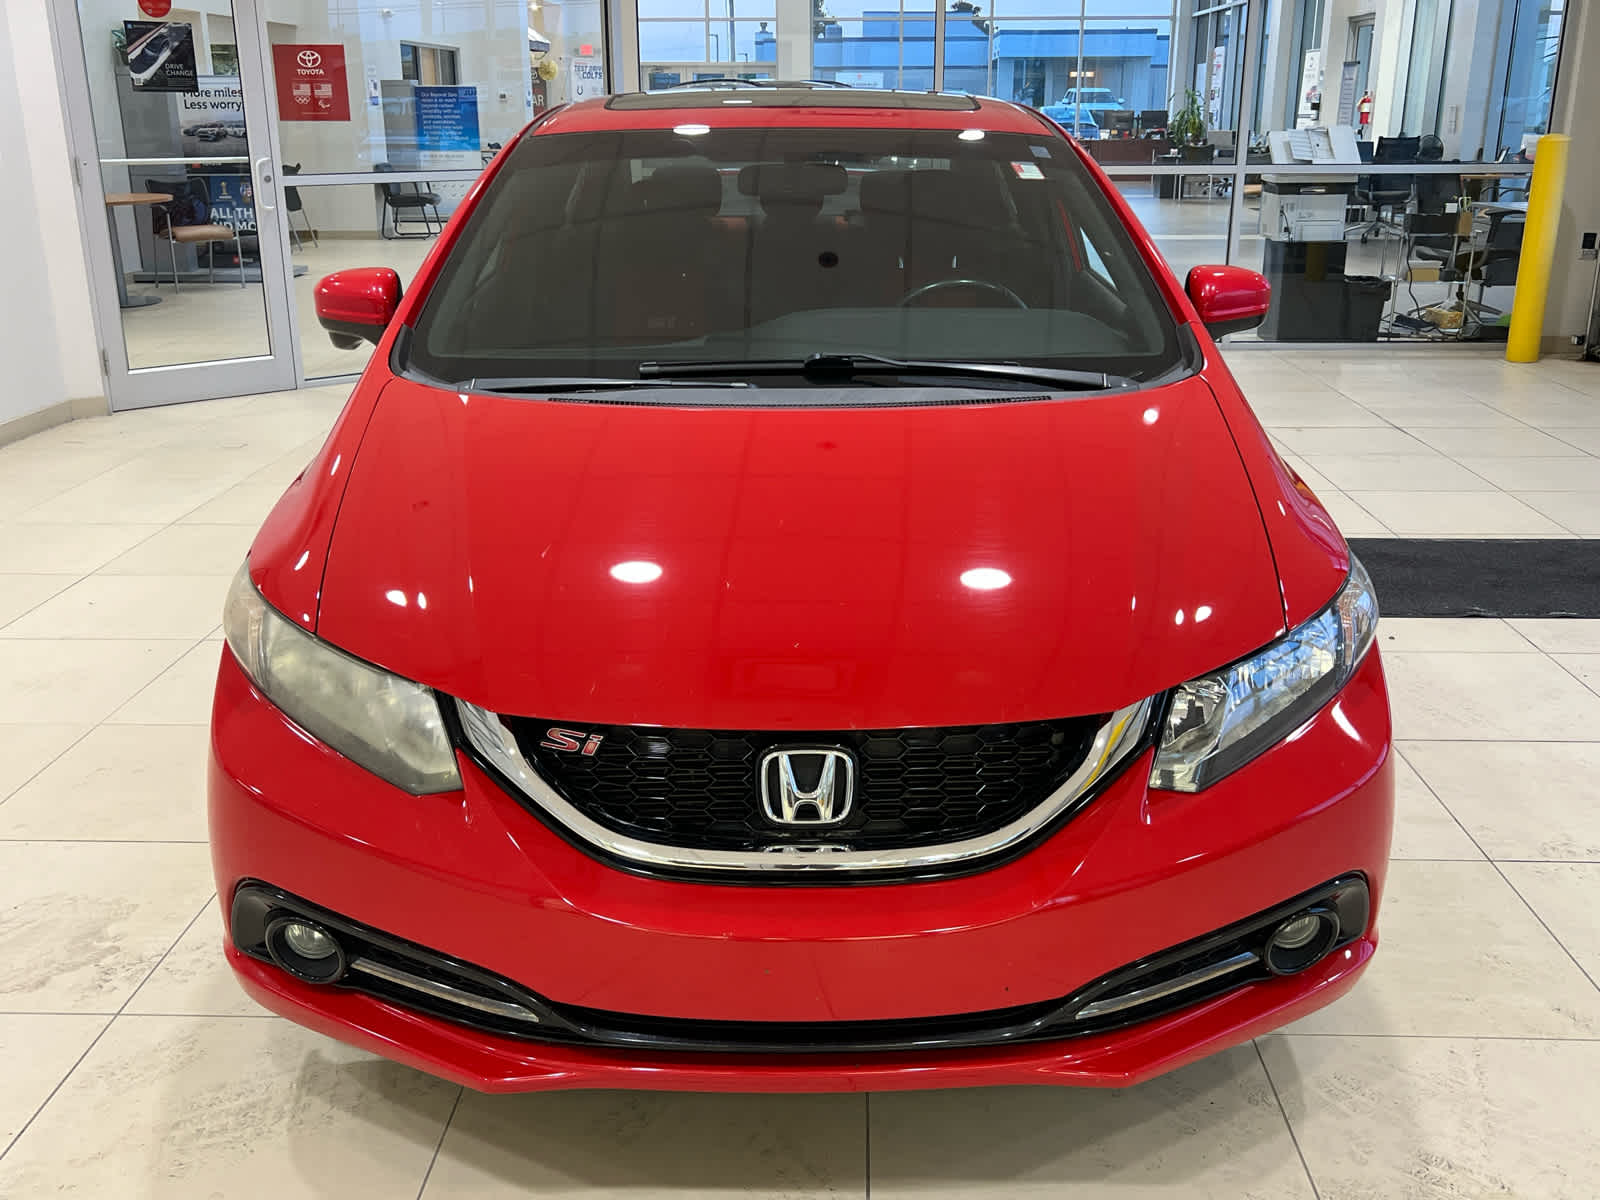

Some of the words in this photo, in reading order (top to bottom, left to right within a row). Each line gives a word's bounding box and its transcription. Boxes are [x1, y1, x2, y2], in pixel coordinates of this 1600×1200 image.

[184, 100, 208, 110] Less
[209, 101, 242, 112] worry
[210, 207, 233, 219] ALL
[540, 727, 604, 756] Si
